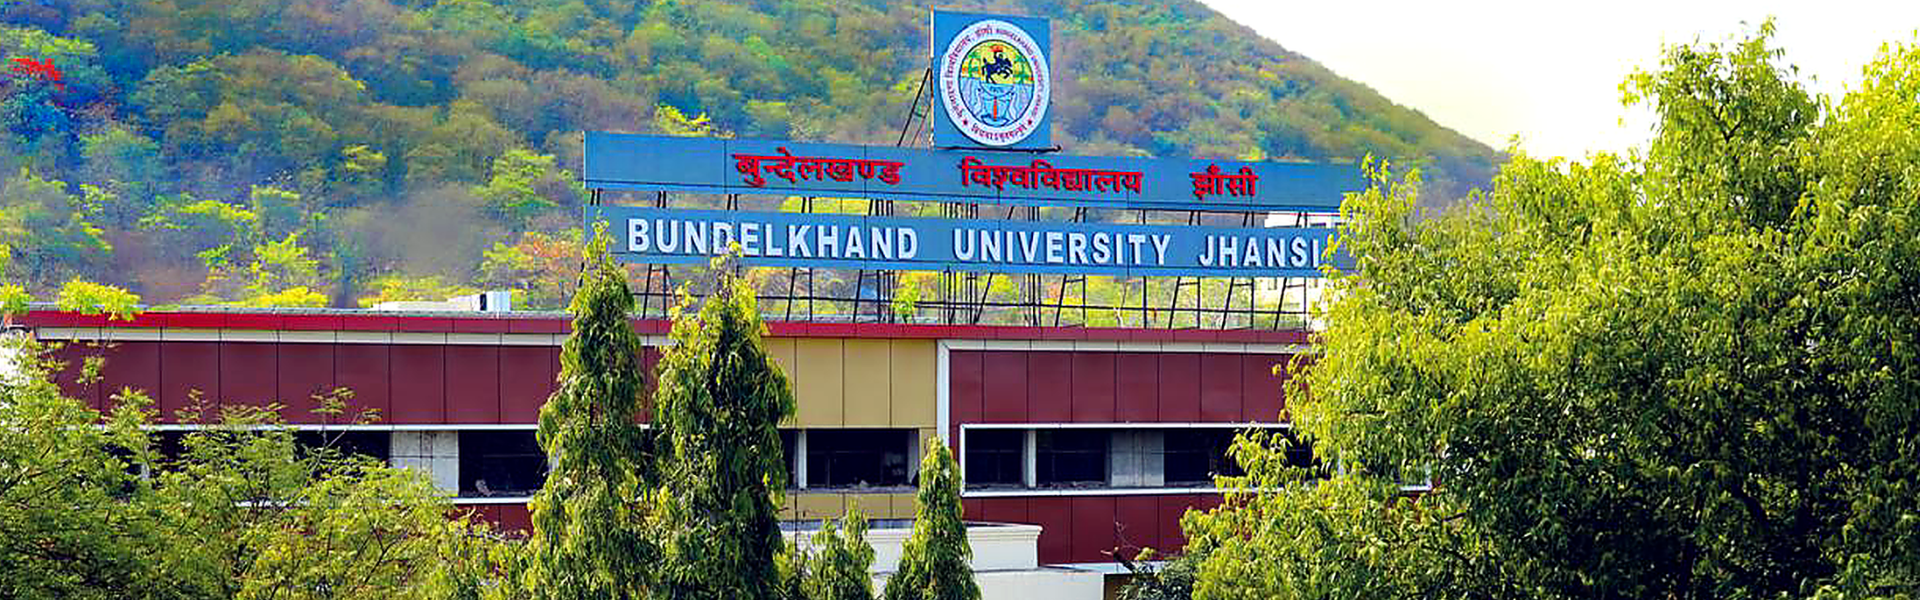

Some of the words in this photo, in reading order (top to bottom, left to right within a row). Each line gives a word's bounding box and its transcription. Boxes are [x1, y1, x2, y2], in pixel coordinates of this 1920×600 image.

[732, 147, 904, 187] बुन्देलखण्ड
[959, 156, 1142, 193] विश्वविद्यालय
[1190, 165, 1259, 199] झाँसी
[627, 218, 918, 260] BUNDELKHAND
[954, 228, 1172, 266] UNIVERSITY
[1199, 235, 1319, 267] JHANSI
